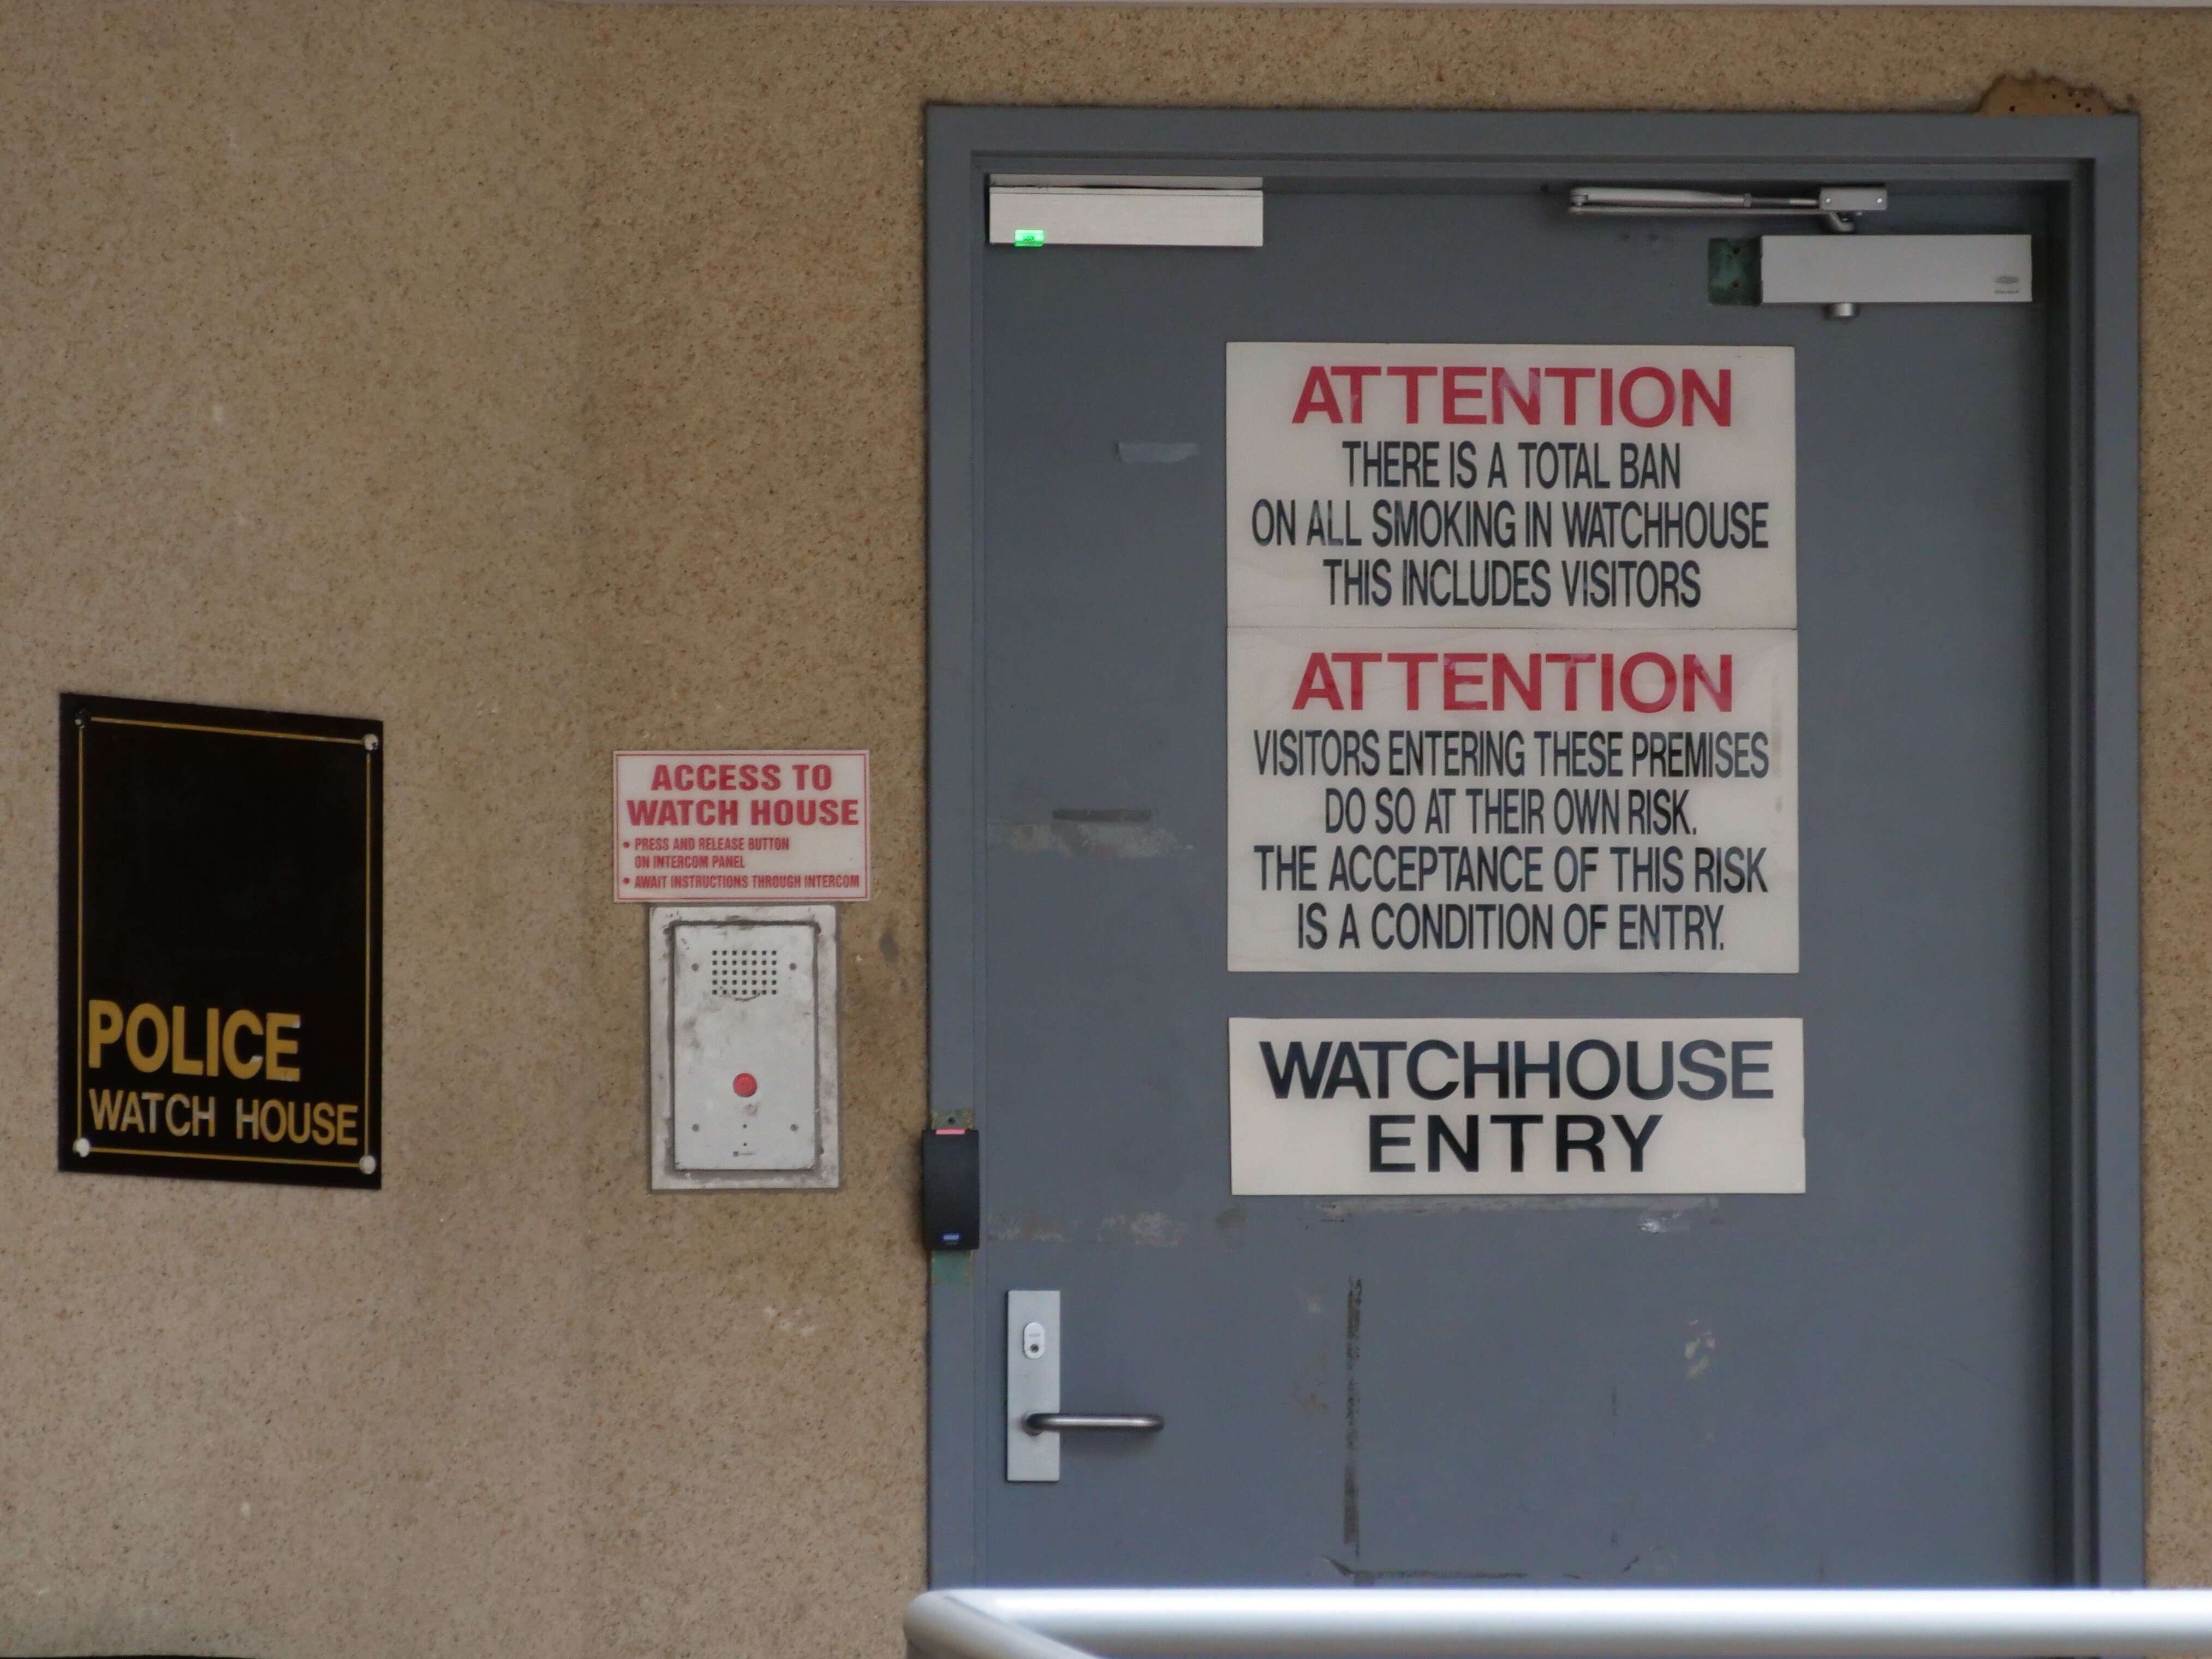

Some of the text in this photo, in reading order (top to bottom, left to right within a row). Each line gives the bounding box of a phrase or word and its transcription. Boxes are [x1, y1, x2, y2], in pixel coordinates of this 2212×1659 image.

[1293, 366, 1732, 428] ATTENTION
[1343, 441, 1680, 490] THERE IS A TOTAL BAN
[1253, 499, 1769, 550] ON ALL SMOKING IN WATCHHOUSE
[1323, 559, 1701, 608] THIS INCLUDES VISITORS
[1293, 652, 1733, 714] ATTENTION
[651, 764, 832, 791] ACCESS TO
[1254, 730, 1769, 779] VISITORS ENTERING THESE PREMISES
[627, 799, 859, 826] WATCH HOUSE
[1326, 788, 1697, 836] DO SO AT THEIR OWN RISK.
[635, 838, 789, 850] PRESS AND RELEASE BUTTON
[635, 856, 745, 868] ON INTERCOM PANEL
[635, 875, 860, 888] AWAIT INSTRUCTIONS THROUGH INTERCOM
[1254, 845, 1768, 894] THE ACCEPTANCE OF THIS RISK
[1299, 903, 1725, 951] IS A CONDITION OF ENTRY.
[88, 999, 301, 1082] POLICE
[1260, 1040, 1774, 1101] WATCHHOUSE
[89, 1088, 359, 1146] WATCH HOUSE
[1370, 1115, 1663, 1173] ENTRY
